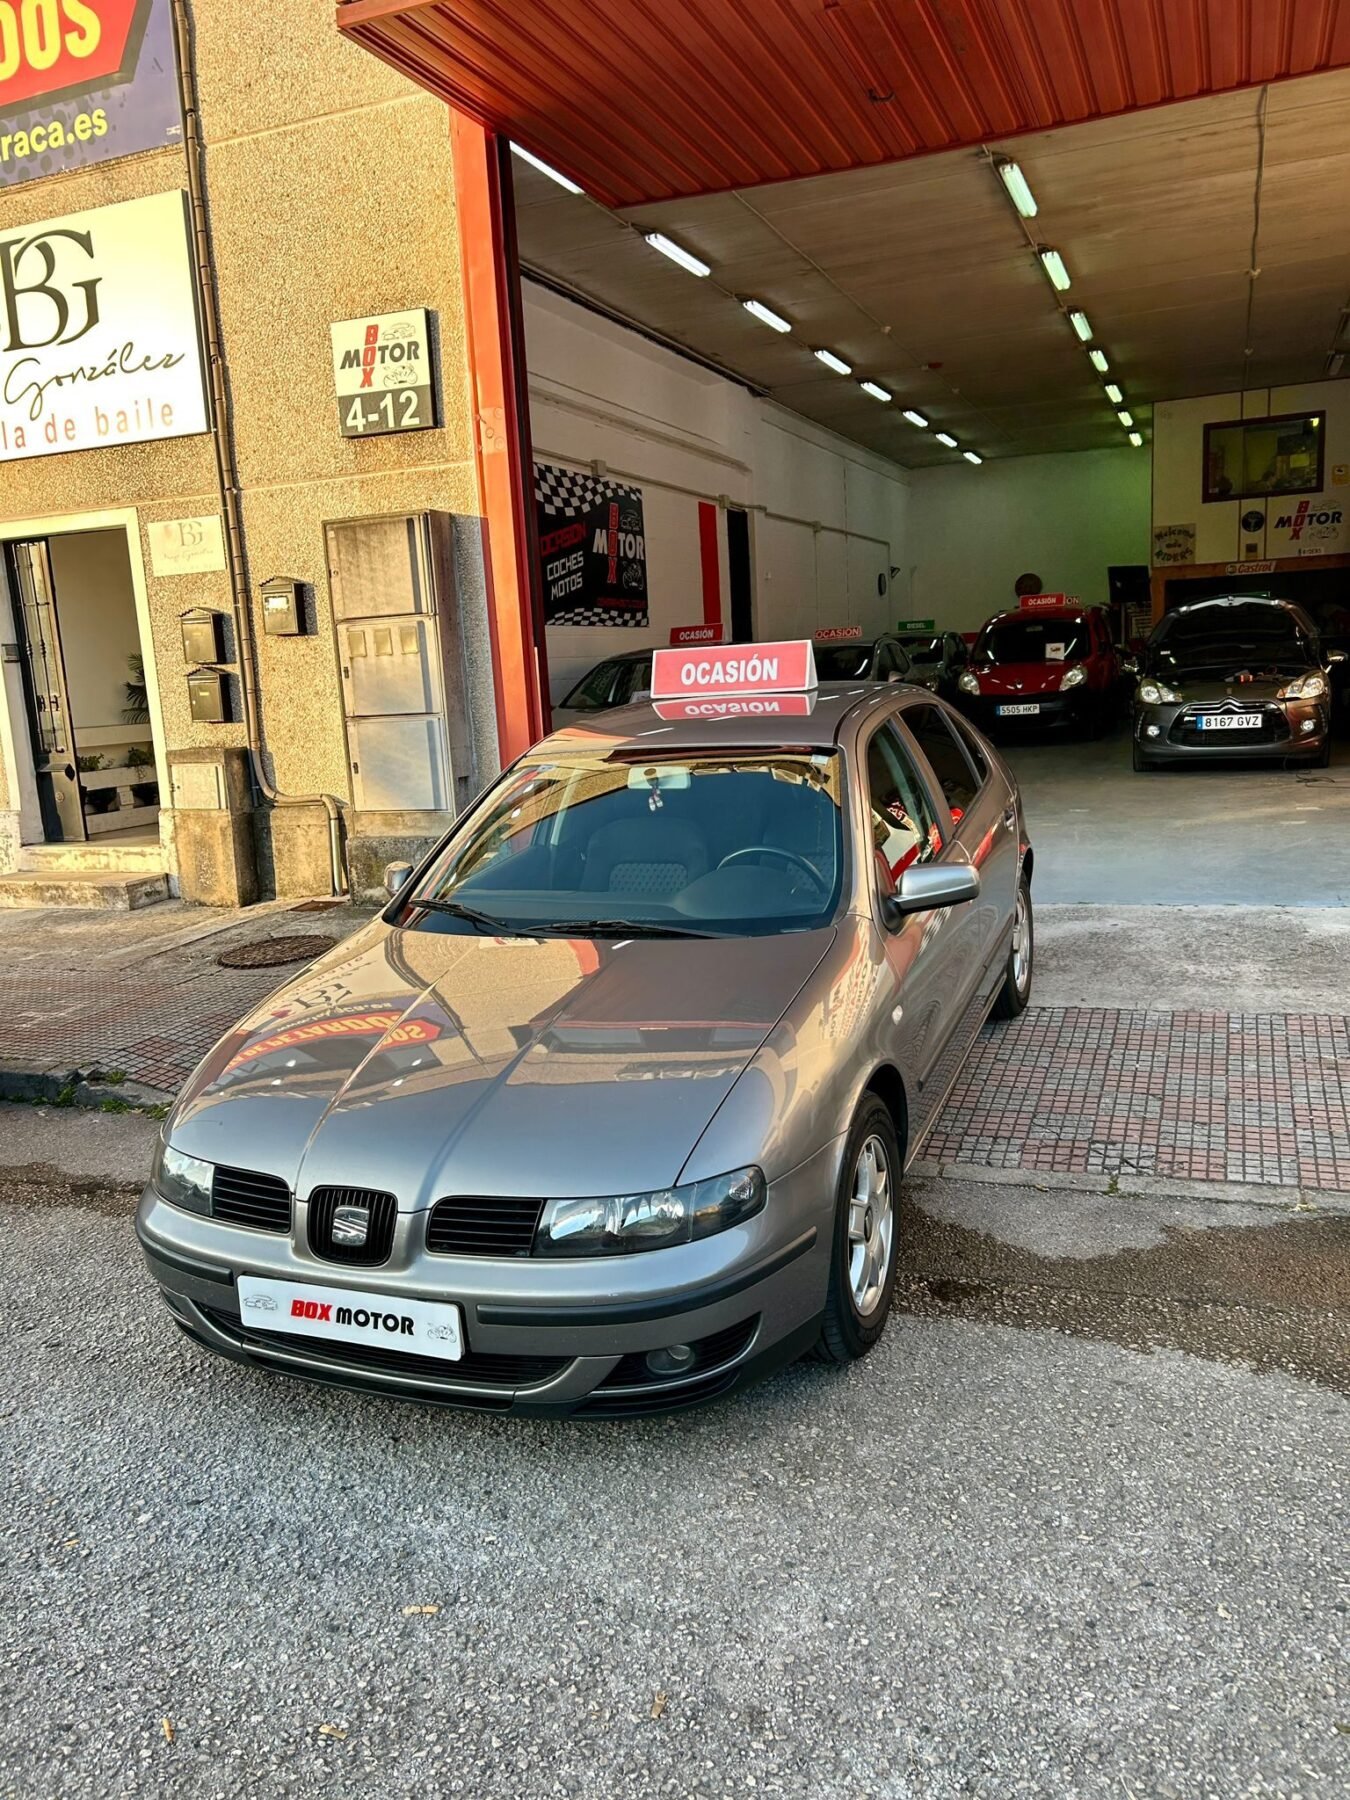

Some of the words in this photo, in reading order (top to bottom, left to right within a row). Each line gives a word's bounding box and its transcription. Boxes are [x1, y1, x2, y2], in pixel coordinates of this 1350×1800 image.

[0, 108, 108, 164] raca.es
[339, 340, 420, 370] MOTOR
[359, 323, 379, 389] BOX
[4, 341, 186, 421] González
[44, 412, 76, 444] de
[95, 397, 174, 437] baile
[346, 389, 421, 433] 4-12
[1273, 510, 1343, 529] MOTOR
[1289, 500, 1311, 541] BOX
[592, 528, 645, 560] MOTOR
[606, 502, 620, 584] BOX
[546, 550, 585, 581] COCHES
[1237, 560, 1274, 574] Castrol
[550, 571, 584, 601] MOTOS
[679, 628, 714, 641] OCASIÓN
[680, 653, 779, 686] OCASIÓN
[1022, 704, 1038, 713] HKP
[1205, 716, 1234, 728] 8167
[1237, 715, 1260, 727] GVZ
[290, 1299, 333, 1322] BOX
[335, 1306, 415, 1336] MOTOR
